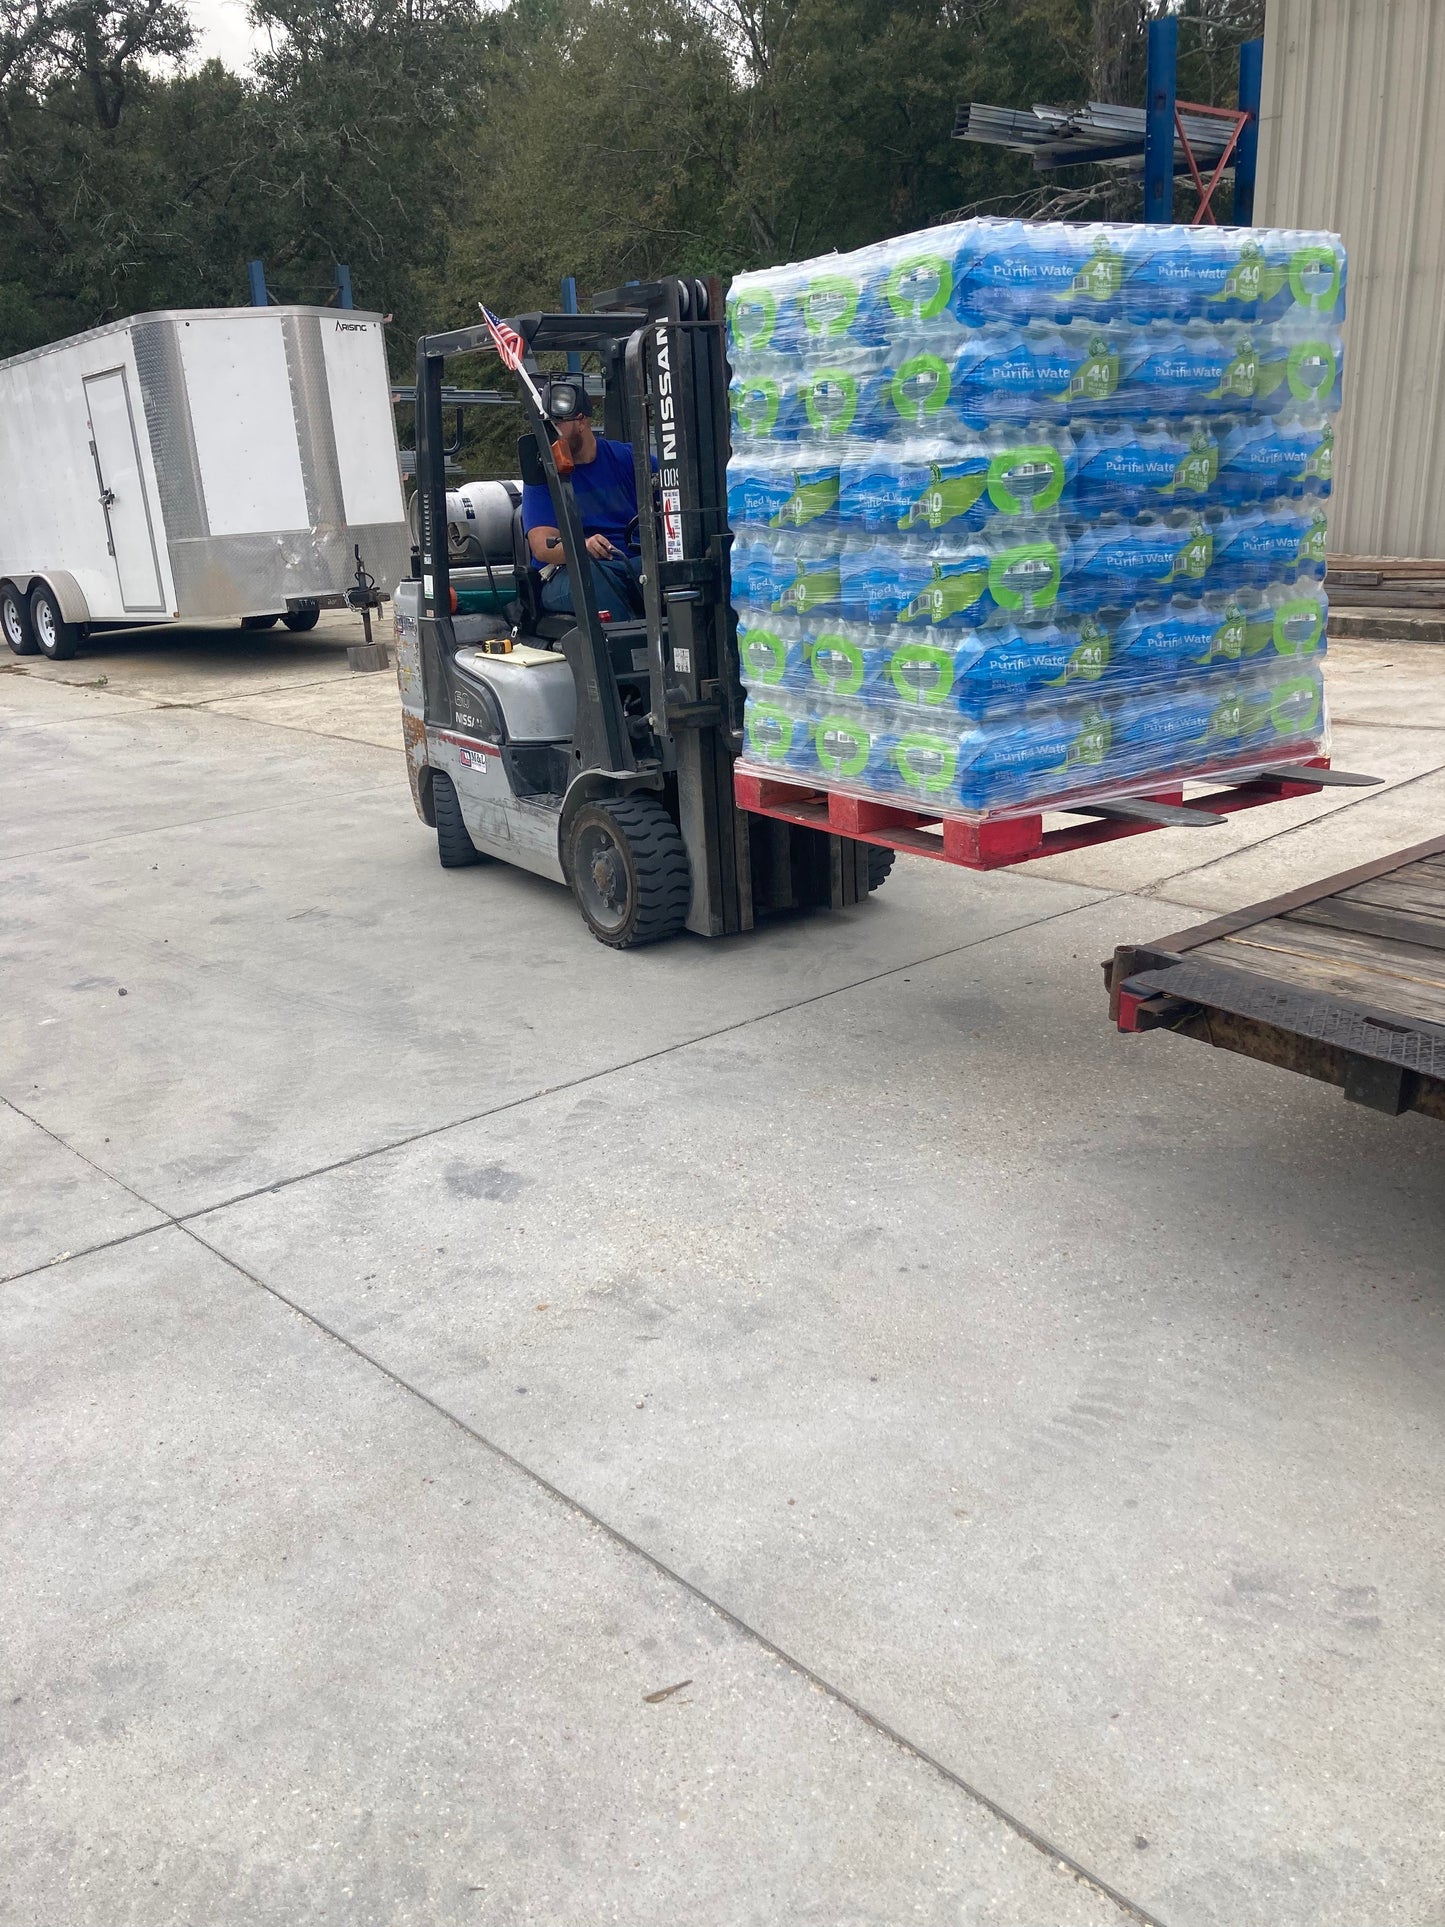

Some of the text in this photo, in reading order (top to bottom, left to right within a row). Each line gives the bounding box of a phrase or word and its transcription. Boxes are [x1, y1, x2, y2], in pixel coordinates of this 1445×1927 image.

[1040, 266, 1074, 276] Wate
[1196, 268, 1226, 279] Wate
[1239, 266, 1260, 283] 40
[1036, 367, 1070, 378] Wate
[1087, 364, 1109, 382] 40
[1193, 367, 1222, 377] Wate
[1234, 362, 1254, 379] 40
[654, 316, 678, 460] NISSAN
[1146, 462, 1175, 472] Wate
[1188, 458, 1210, 475] 40
[1144, 552, 1174, 563] Wate
[1184, 634, 1212, 643] Wate
[1080, 647, 1102, 663] 40
[1082, 734, 1104, 749] 40
[1037, 744, 1067, 754] Wate
